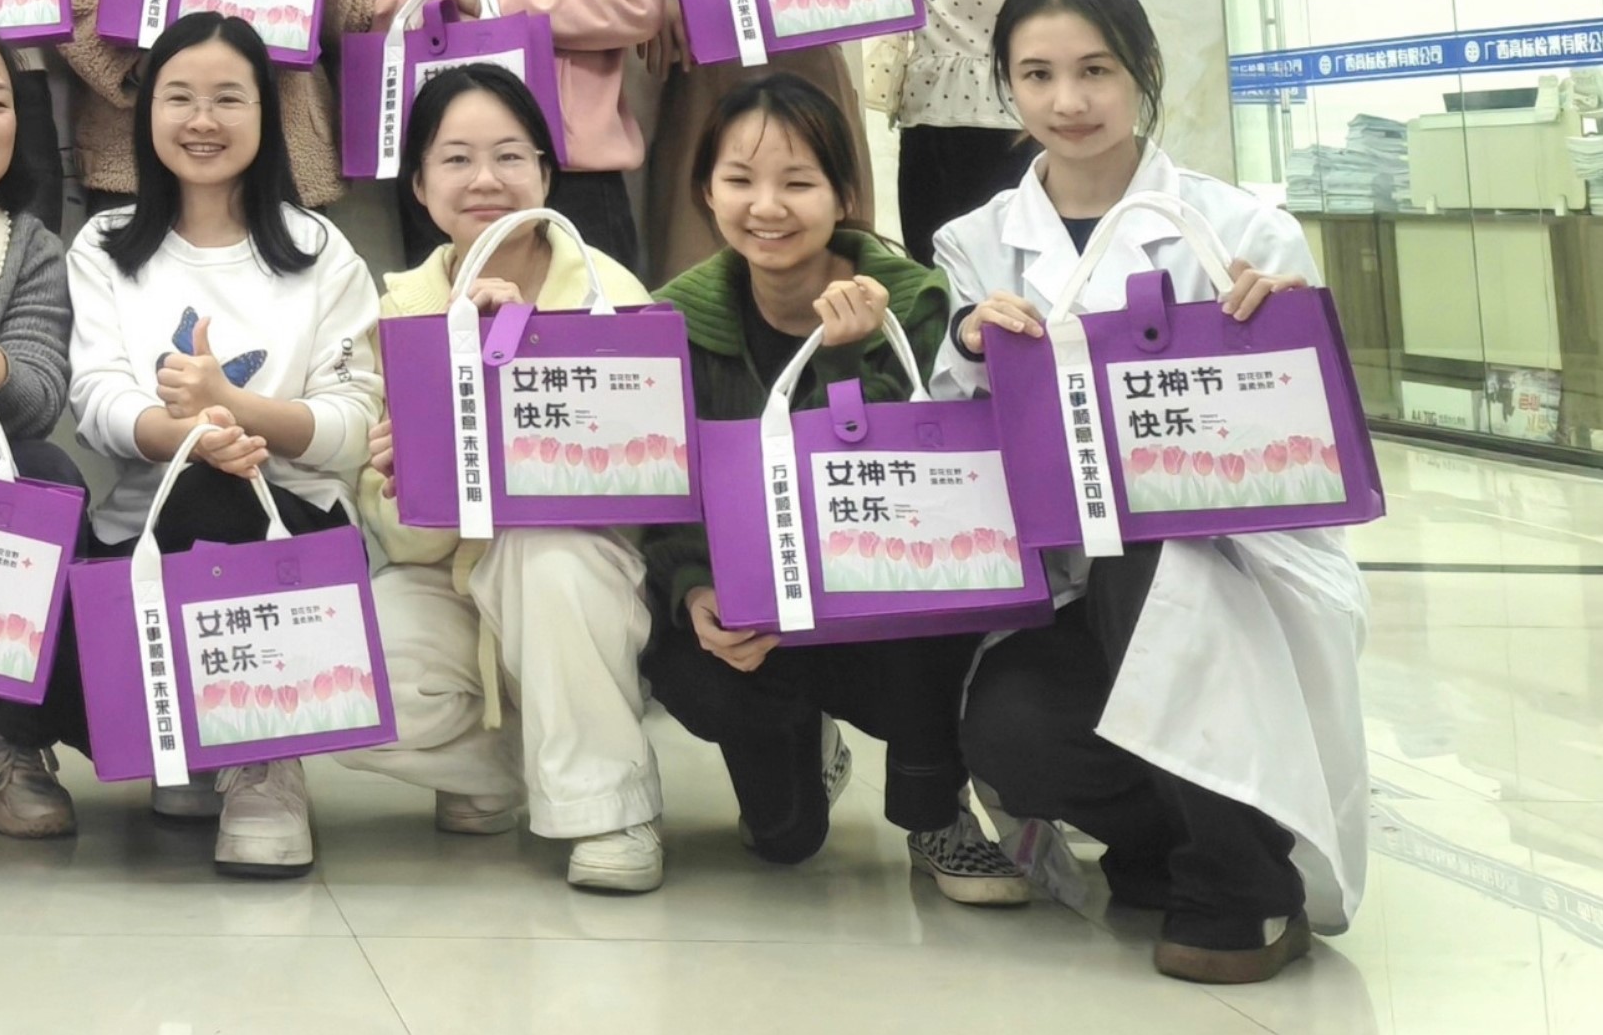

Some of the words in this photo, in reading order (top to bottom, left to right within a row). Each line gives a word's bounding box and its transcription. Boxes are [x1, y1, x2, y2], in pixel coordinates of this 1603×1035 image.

[1484, 31, 1603, 60] 广西高标检测有限公
[513, 366, 597, 393] 女神节
[1123, 367, 1223, 399] 女神节
[458, 366, 477, 430] 万事顺意
[1068, 374, 1094, 443] 万事顺意
[513, 403, 571, 429] 快乐
[1129, 408, 1196, 439] 快乐
[463, 436, 482, 501] 未来可期
[826, 460, 916, 487] 女神节
[1079, 449, 1106, 518] 未来可期
[772, 465, 794, 527] 万事顺意
[829, 496, 890, 523] 快乐
[779, 533, 802, 599] 未来可期
[196, 603, 280, 638] 女神节
[144, 609, 166, 677] 万事顺意
[201, 644, 258, 675] 快乐
[152, 682, 175, 751] 未来可期
